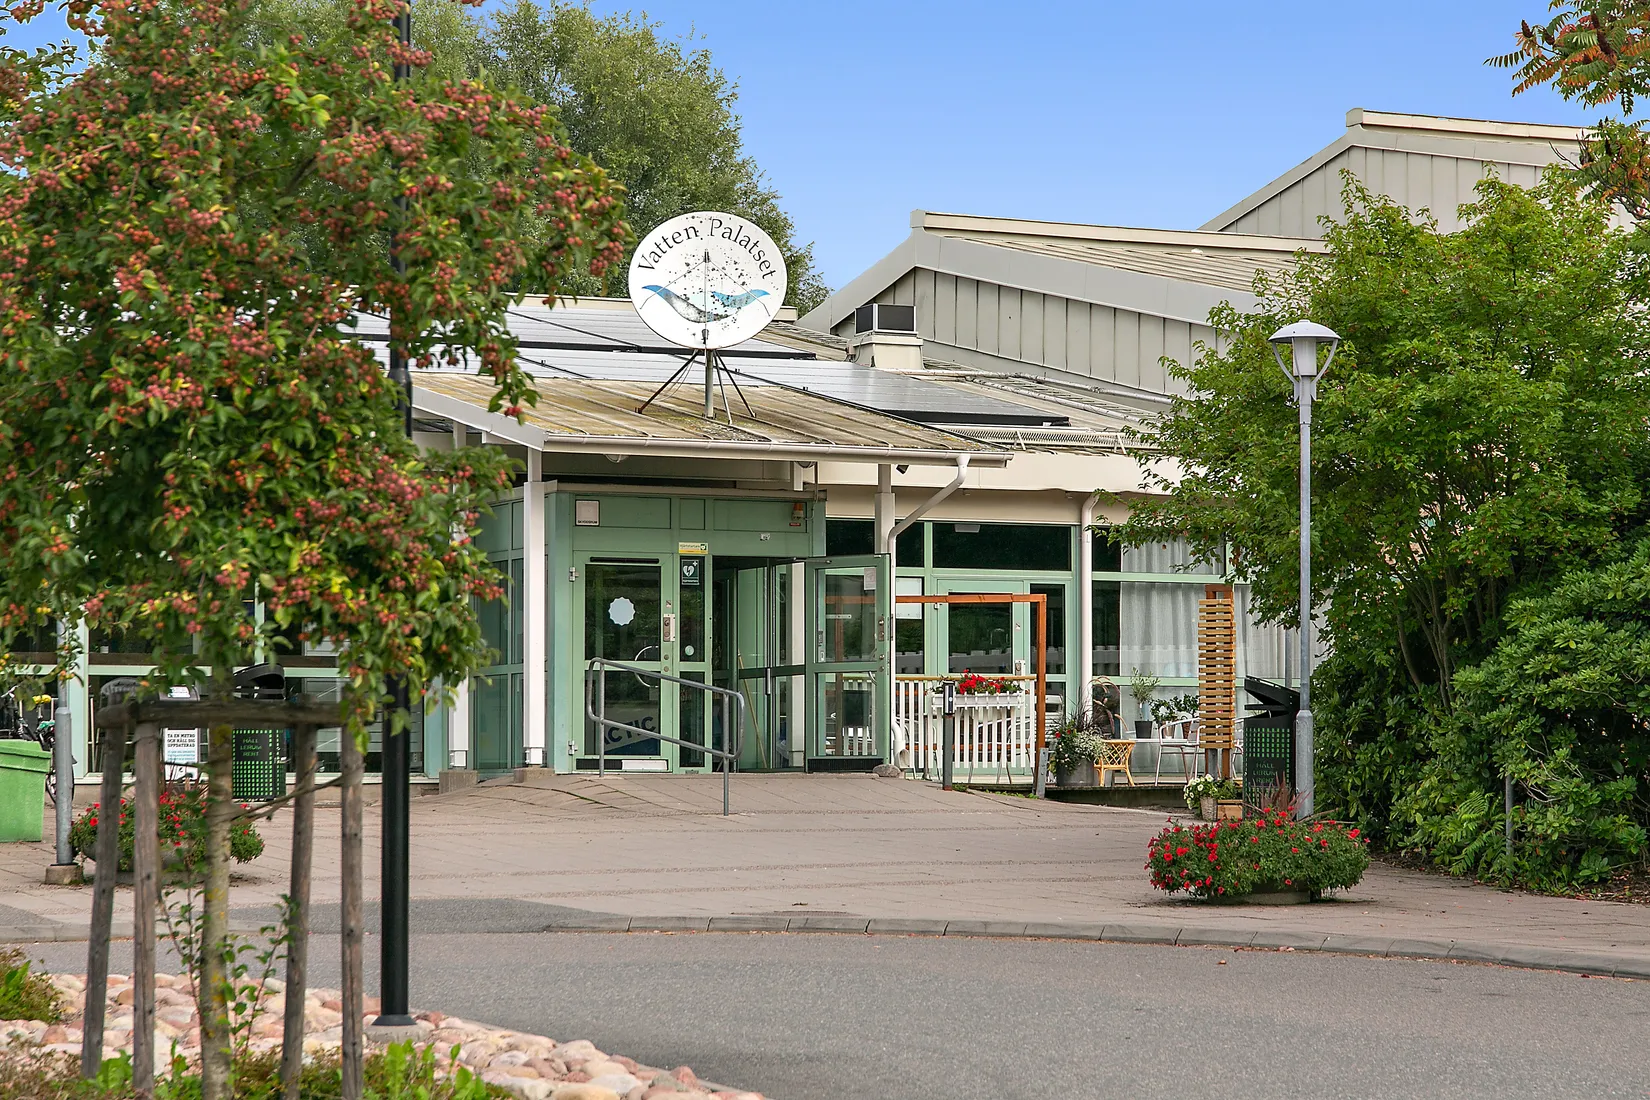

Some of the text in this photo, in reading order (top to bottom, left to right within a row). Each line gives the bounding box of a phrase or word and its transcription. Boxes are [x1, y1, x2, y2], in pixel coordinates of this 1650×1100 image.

[637, 217, 777, 280] Vatten Palatset
[604, 716, 656, 744] CTIC
